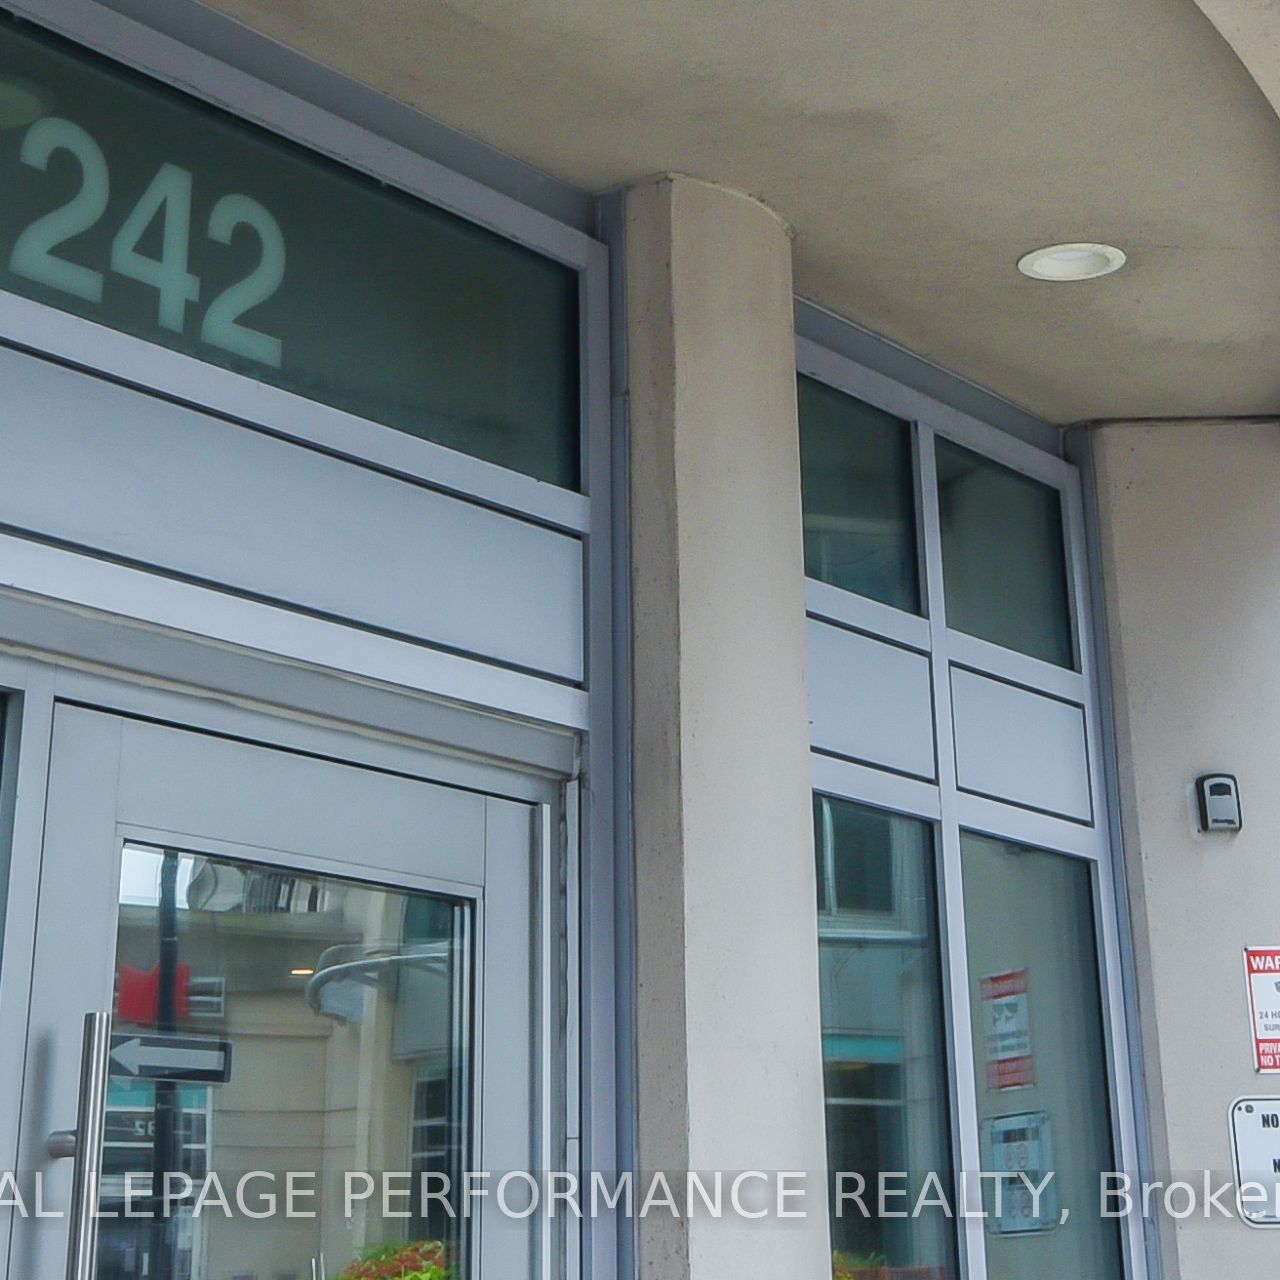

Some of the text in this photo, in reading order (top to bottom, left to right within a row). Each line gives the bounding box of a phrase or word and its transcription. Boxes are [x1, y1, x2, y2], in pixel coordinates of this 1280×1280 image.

[10, 116, 286, 369] 242
[1259, 1011, 1269, 1020] 24
[1261, 1055, 1274, 1066] NO
[1261, 1114, 1279, 1128] NO
